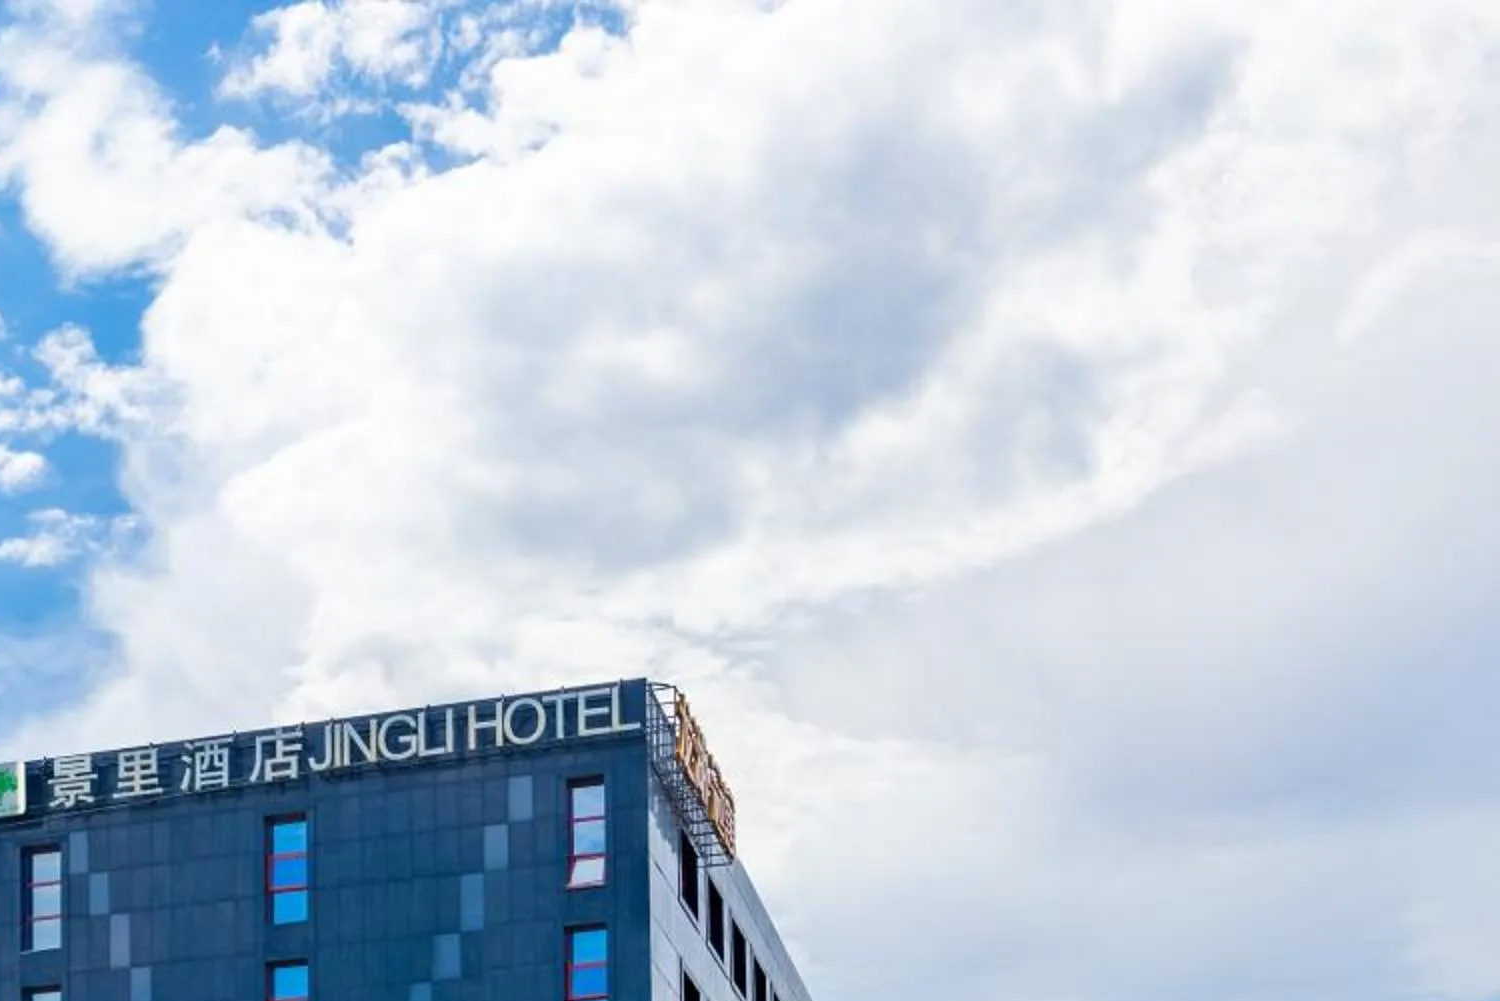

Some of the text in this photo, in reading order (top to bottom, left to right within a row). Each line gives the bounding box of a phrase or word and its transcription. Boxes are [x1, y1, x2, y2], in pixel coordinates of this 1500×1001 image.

[48, 685, 641, 808] 景里酒店 JINGLI HOTEL
